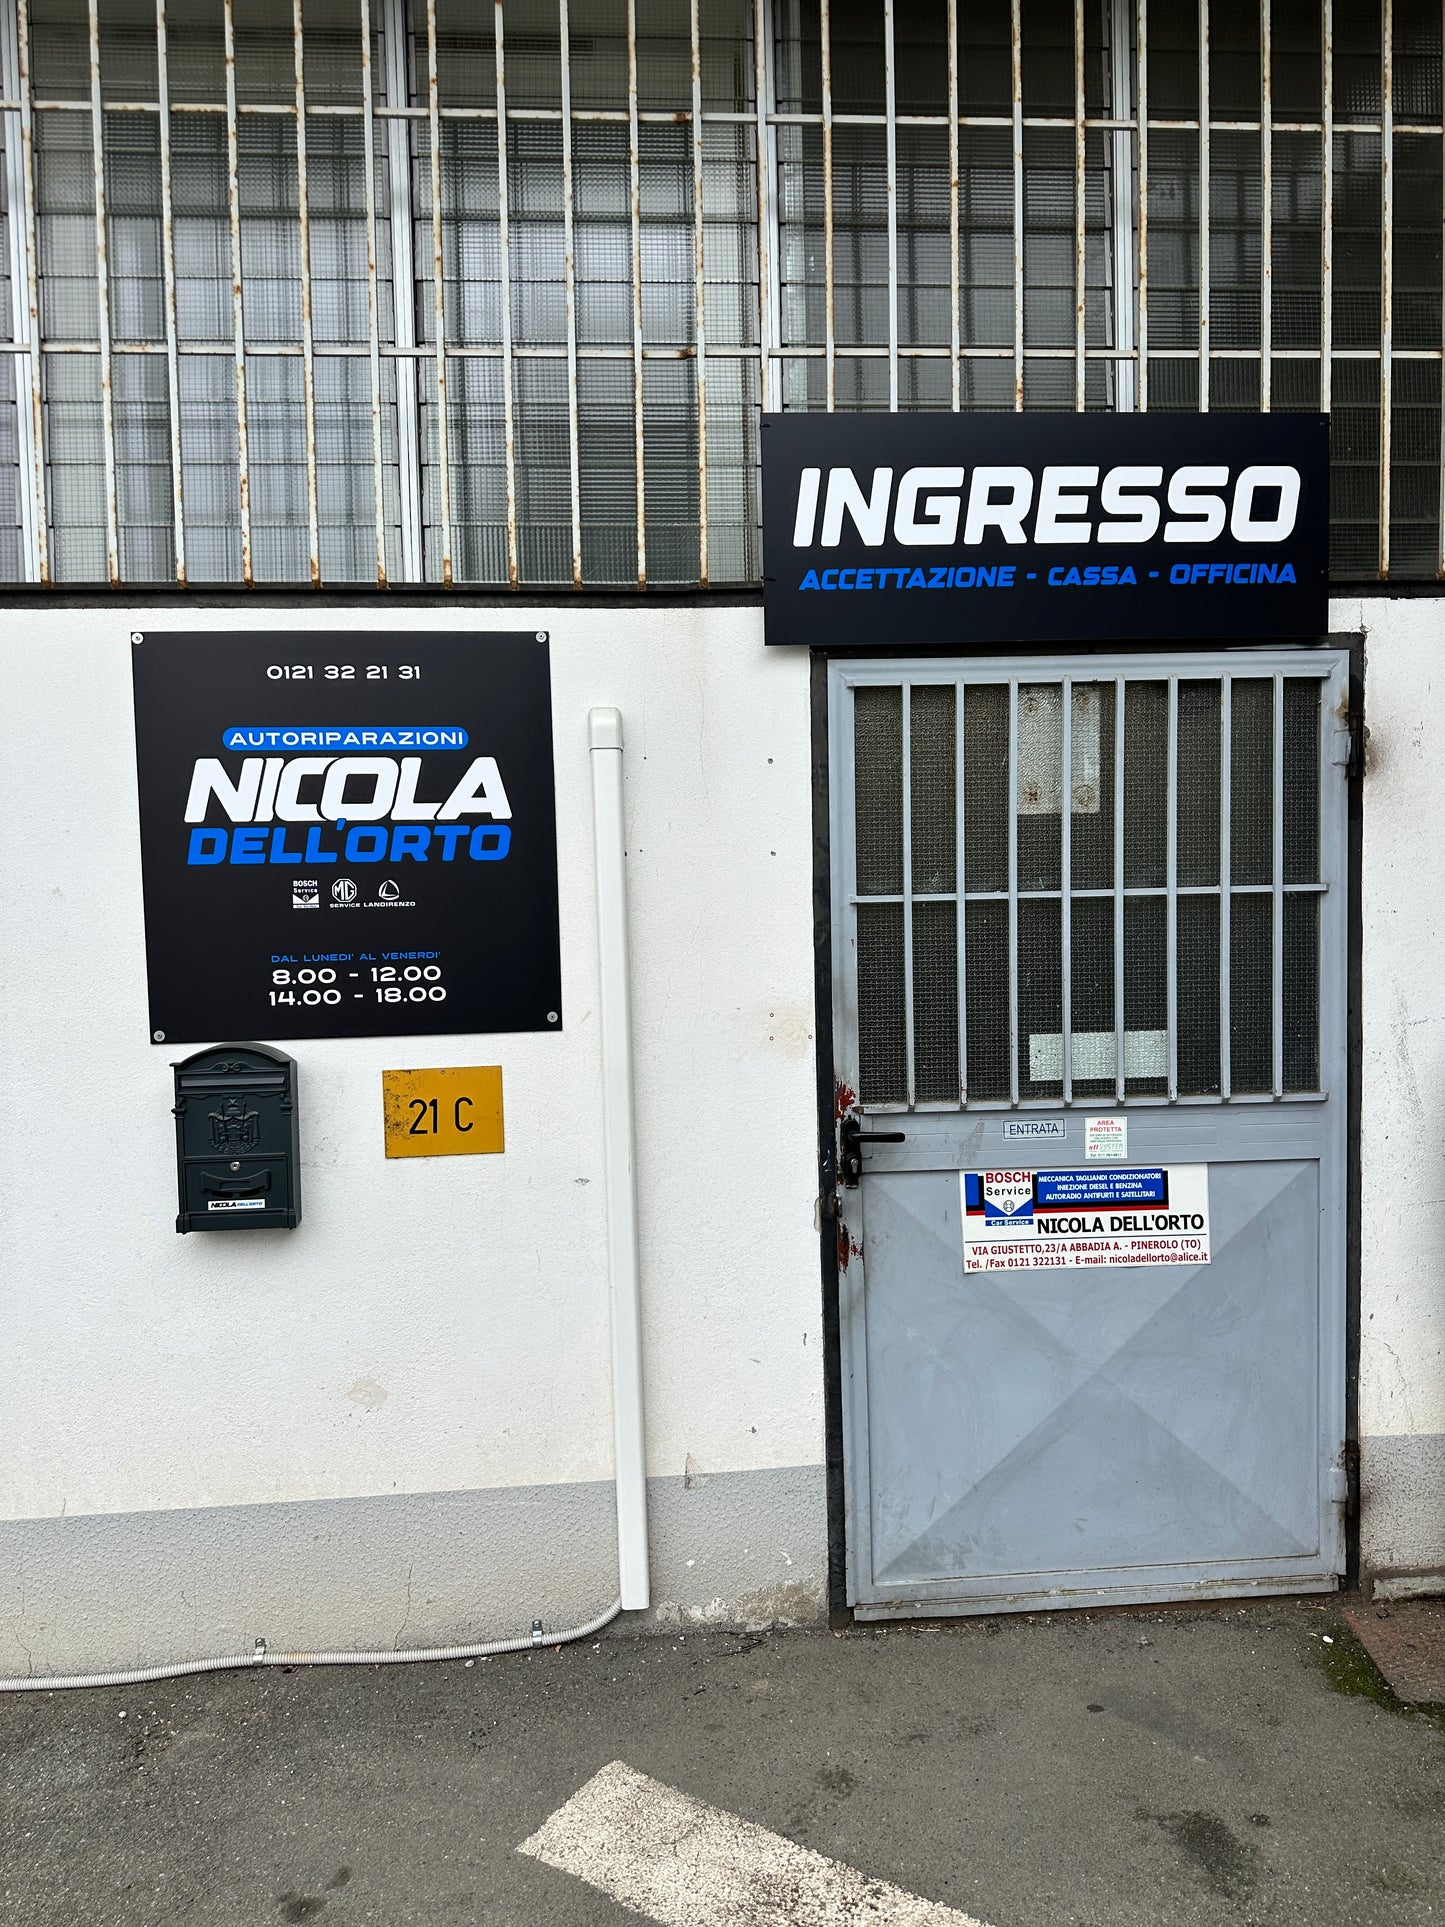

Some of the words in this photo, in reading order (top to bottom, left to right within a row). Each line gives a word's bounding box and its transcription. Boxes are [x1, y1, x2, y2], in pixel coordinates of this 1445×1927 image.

[793, 466, 1301, 548] INGRESSO
[799, 566, 1016, 590] ACCETTAZIONE
[1048, 566, 1137, 587] CASSA
[1169, 563, 1297, 584] OFFICINA
[266, 666, 314, 680] 0121
[324, 665, 356, 679] 32
[366, 665, 388, 679] 21
[398, 665, 420, 679] 31
[229, 731, 464, 746] AUTORIPARAZIONI
[184, 756, 512, 822] NICOLA
[187, 818, 512, 865] DELL'ORTO
[334, 880, 354, 900] MG
[304, 954, 354, 962] LUNEDI'
[382, 952, 440, 960] VENERDI'
[272, 968, 336, 984] 8.00
[371, 966, 442, 982] 12.00
[269, 990, 342, 1006] 14.00
[376, 986, 446, 1002] 18.00
[408, 1098, 438, 1134] 21
[455, 1097, 474, 1132] C
[1010, 1123, 1058, 1135] ENTRATA
[986, 1172, 1030, 1183] BOSCH
[986, 1186, 1031, 1196] Service
[1038, 1217, 1104, 1234] NICOLA
[1110, 1214, 1204, 1232] DELL'ORTO
[972, 1246, 988, 1255] VIA
[991, 1243, 1067, 1255] GIUSTETTO,23/A
[1070, 1242, 1111, 1252] ABBADIA
[1113, 1242, 1122, 1250] A.
[1131, 1240, 1178, 1250] PINEROLO
[1181, 1239, 1201, 1250] (TO)
[966, 1260, 982, 1269] Tel.
[985, 1259, 1005, 1269] /Fax
[1008, 1258, 1030, 1267] 0121
[1033, 1256, 1066, 1266] 322131
[1076, 1255, 1107, 1264] E-mail:
[1110, 1252, 1208, 1263] nicoladellorto@alice.it
